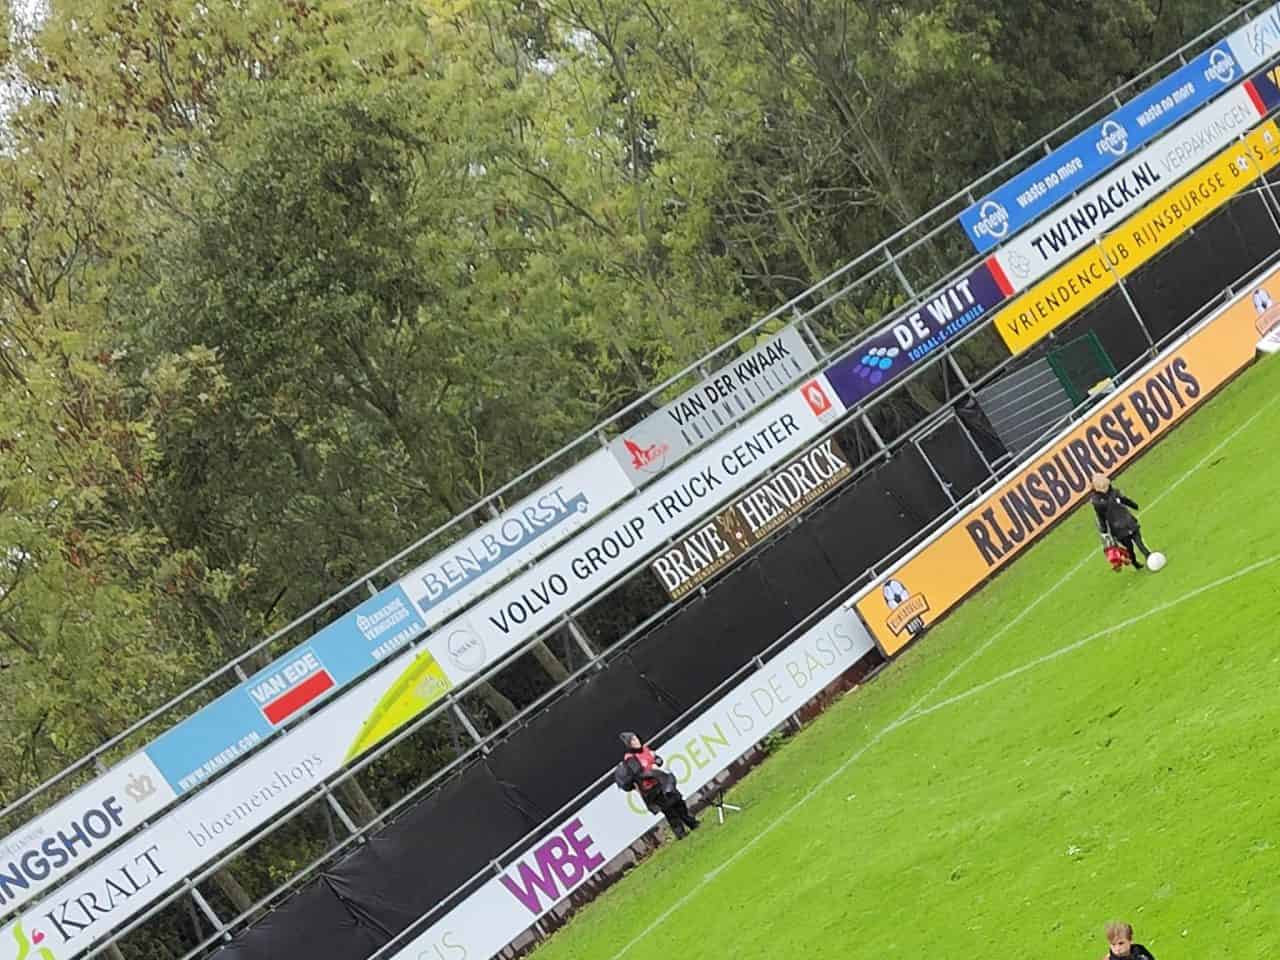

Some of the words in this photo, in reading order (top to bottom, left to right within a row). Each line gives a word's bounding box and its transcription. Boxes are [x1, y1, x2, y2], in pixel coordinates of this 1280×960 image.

[1136, 105, 1164, 127] waste
[1170, 83, 1195, 109] more
[973, 208, 1008, 238] renew
[1016, 182, 1047, 208] waste
[1056, 157, 1084, 188] more
[1031, 161, 1161, 261] TWINPACK.NL
[1160, 102, 1252, 173] VERPAKKINGEN
[1008, 243, 1130, 336] VRIENDENCLUB
[1132, 175, 1225, 248] RIJNSBURGSE
[893, 313, 930, 350] DE
[927, 279, 974, 325] WIT
[668, 392, 706, 426] VAN
[703, 374, 736, 405] DER
[735, 338, 791, 385] KWAAK
[653, 523, 729, 592] BRAVE
[738, 440, 847, 532] HENDRICK
[965, 402, 1144, 568] RIJNSBURGSE
[1132, 357, 1200, 434] BOYS
[423, 547, 481, 602] BEN
[480, 486, 571, 557] BORST
[489, 574, 569, 634] VOLVO
[571, 516, 645, 580] GROUP
[648, 467, 722, 525] TRUCK
[721, 413, 800, 475] CENTER
[250, 674, 288, 703] VAN
[286, 652, 320, 684] EDE
[728, 703, 754, 736] IS
[751, 675, 790, 718] DE
[786, 624, 854, 684] BASIS
[43, 845, 166, 943] KRALT
[187, 751, 323, 849] bloemenshops
[500, 818, 605, 915] WBE
